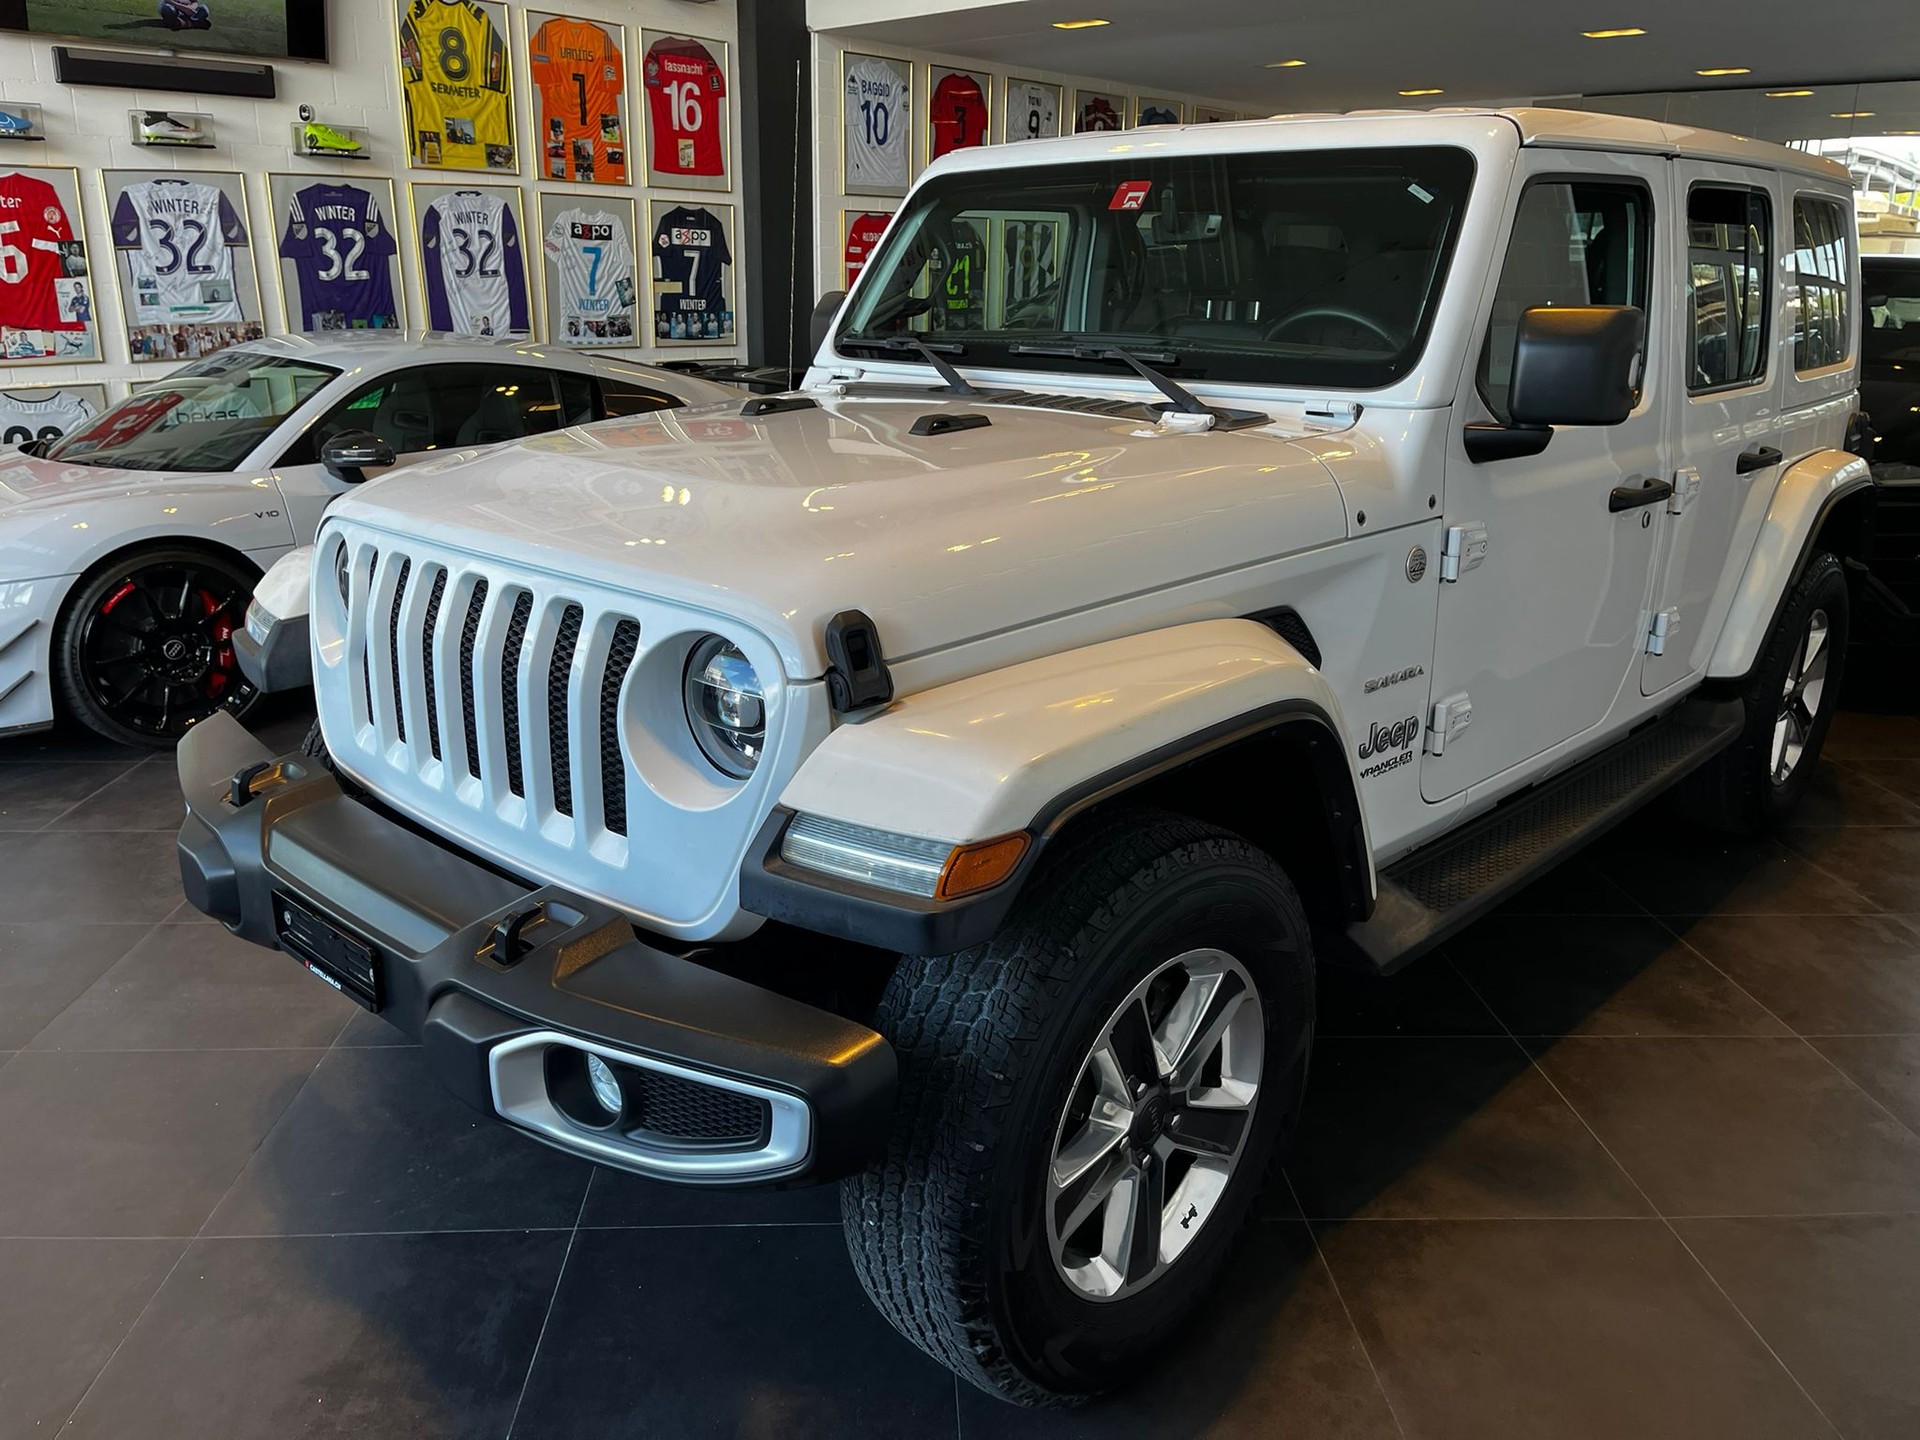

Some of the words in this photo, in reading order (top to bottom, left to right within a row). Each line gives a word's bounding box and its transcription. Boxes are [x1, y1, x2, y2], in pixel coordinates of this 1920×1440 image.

[438, 27, 471, 82] 8
[572, 73, 588, 126] 1
[663, 80, 702, 132] 16
[861, 80, 890, 97] BAGGIO
[860, 100, 889, 146] 10
[952, 106, 966, 144] 3
[1027, 110, 1040, 139] 9
[151, 199, 199, 215] WINTER
[314, 204, 356, 222] WINTER
[453, 211, 489, 226] WINTER
[149, 218, 216, 276] 32
[314, 227, 370, 282] 32
[452, 228, 501, 278] 32
[582, 246, 602, 296] 7
[684, 250, 700, 296] 7
[578, 298, 609, 311] WINTER
[679, 298, 707, 311] WINTER
[1363, 665, 1424, 694] SAHARA
[1358, 716, 1419, 760] Jeep
[1360, 751, 1413, 779] WRANGLER
